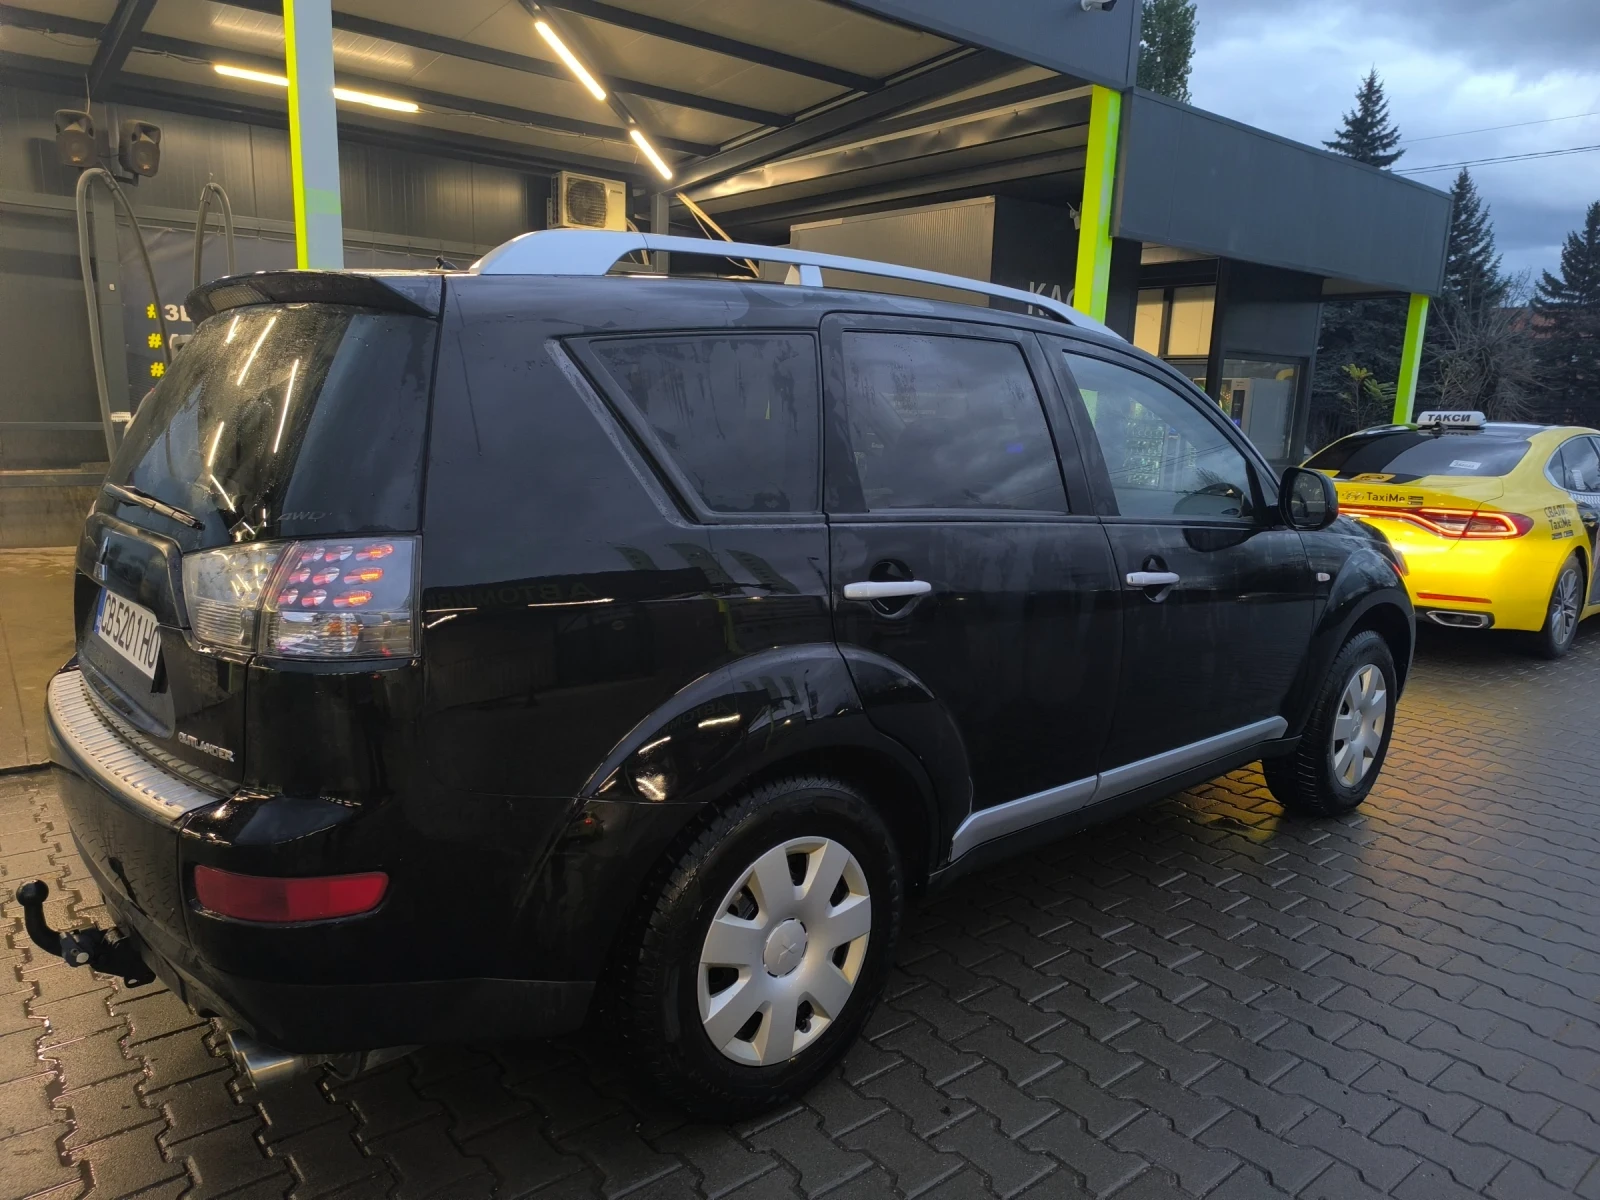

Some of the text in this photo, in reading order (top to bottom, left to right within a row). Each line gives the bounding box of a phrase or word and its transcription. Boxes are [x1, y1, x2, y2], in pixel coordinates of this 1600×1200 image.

[1427, 414, 1471, 422] ТАКСИ
[1366, 491, 1406, 503] TaxiMe
[1549, 517, 1572, 530] TaxiMe
[178, 731, 235, 762] OUTLANDER
